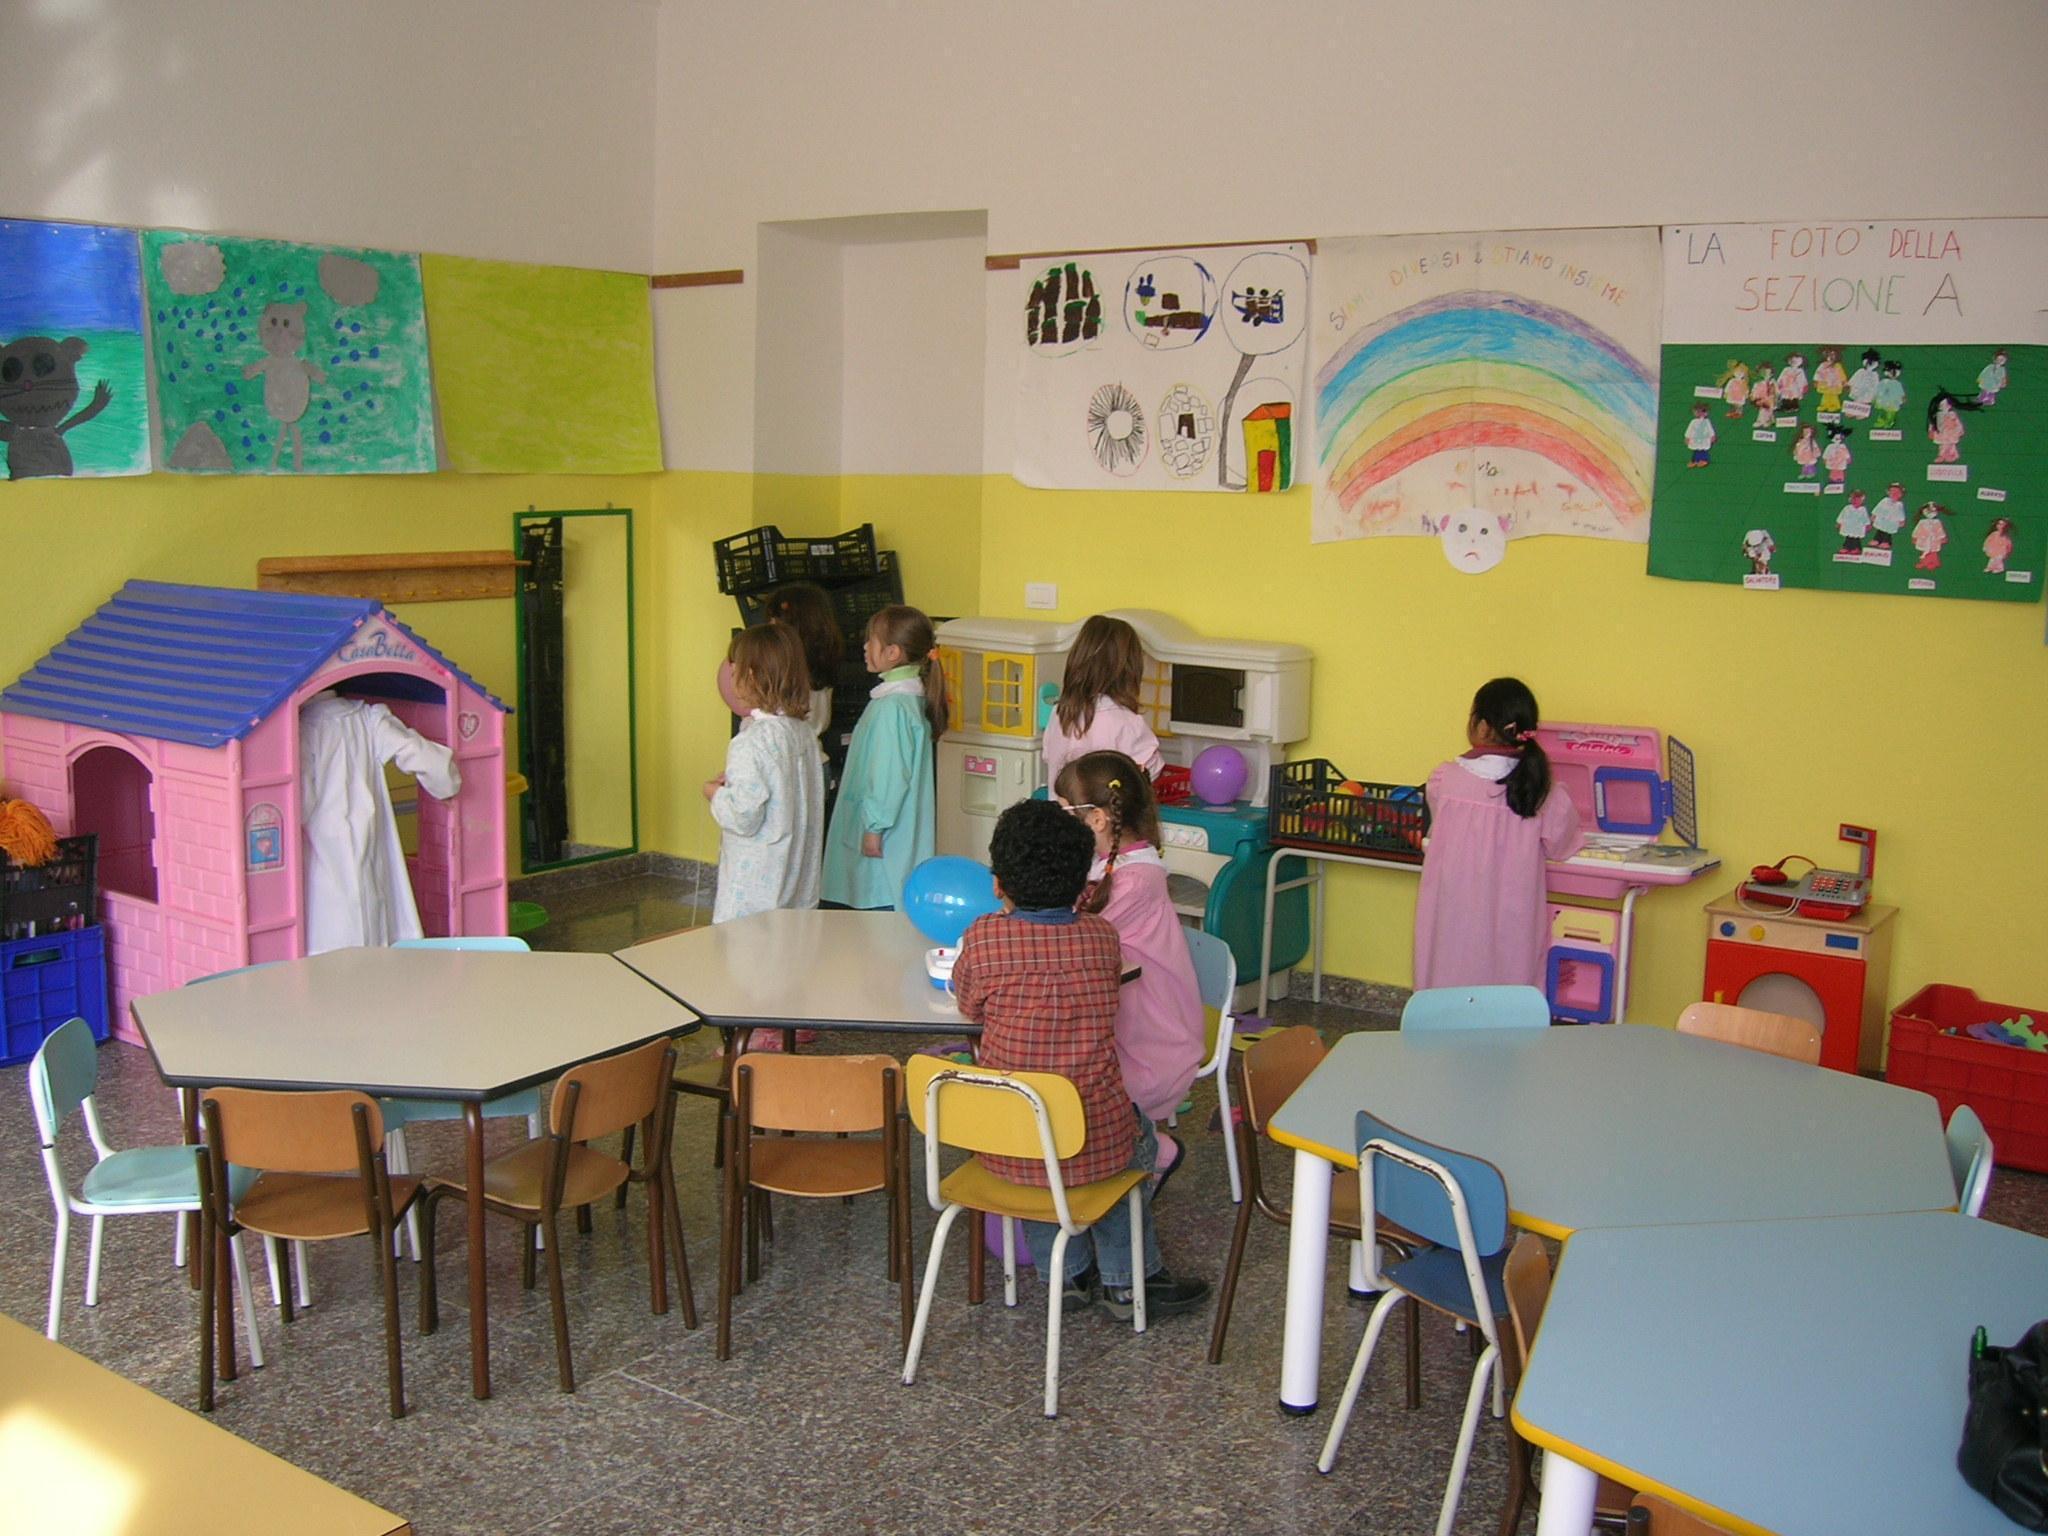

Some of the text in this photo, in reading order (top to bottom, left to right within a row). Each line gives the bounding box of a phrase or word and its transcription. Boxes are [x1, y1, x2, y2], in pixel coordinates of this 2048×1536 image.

[1687, 227, 1961, 265] LA FOTO DELLA
[1735, 273, 1963, 316] SEZIONE A
